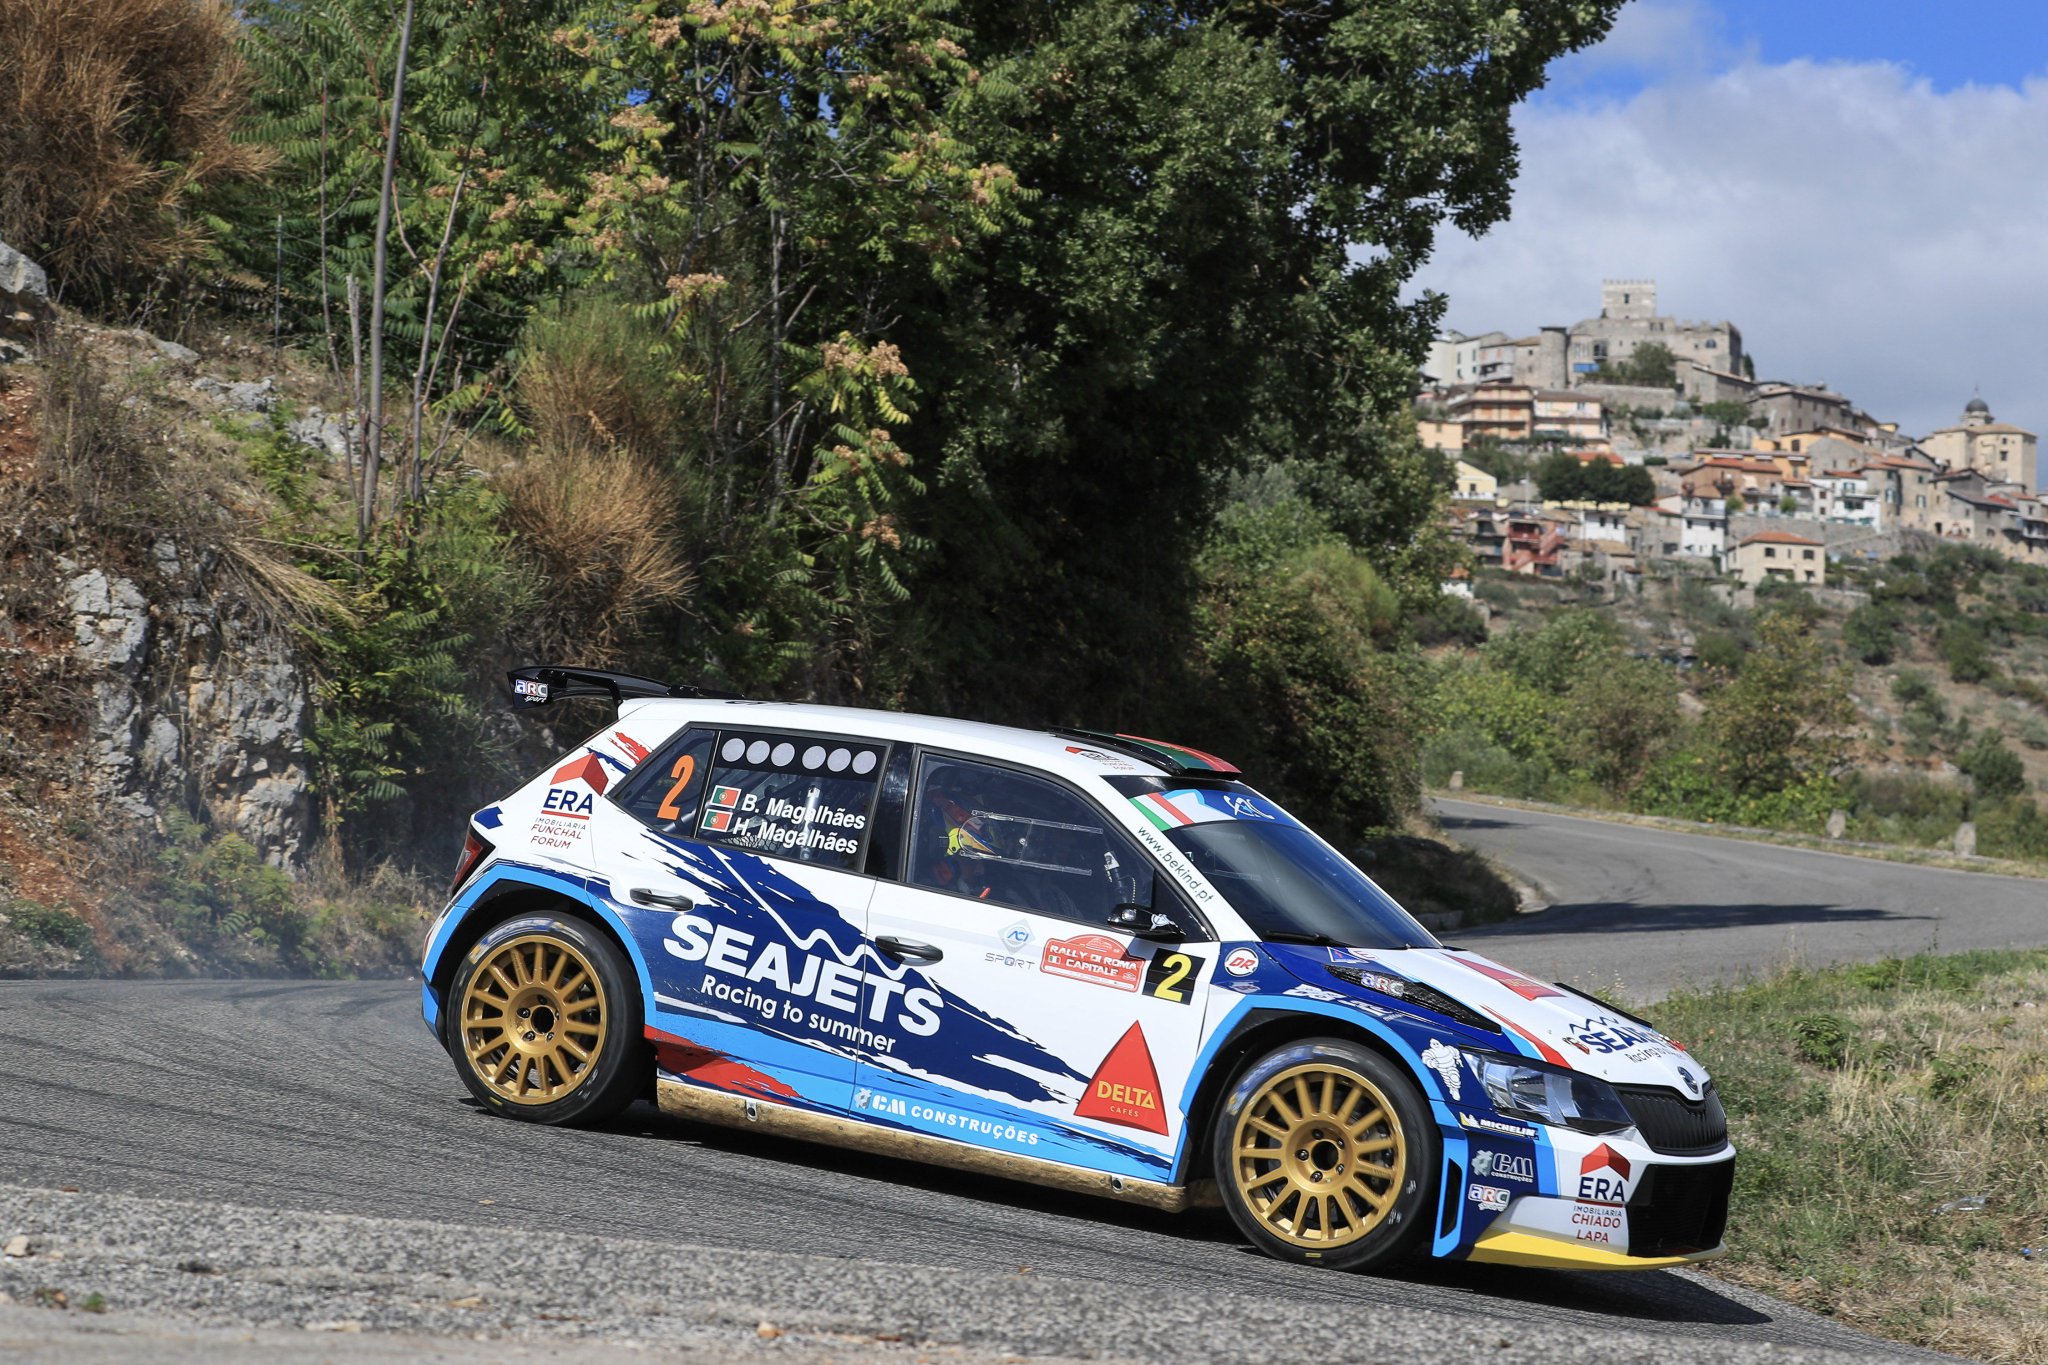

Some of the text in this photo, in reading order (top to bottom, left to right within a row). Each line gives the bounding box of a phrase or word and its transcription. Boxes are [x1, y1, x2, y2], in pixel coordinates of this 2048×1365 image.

[524, 695, 546, 703] sport
[656, 754, 695, 821] 2
[543, 788, 593, 814] ERA
[741, 794, 866, 829] B. Magalhães
[531, 824, 582, 840] FUNCHAL
[531, 836, 571, 849] FORUM
[733, 817, 858, 854] H. Magalhães
[1137, 826, 1214, 903] www.bekind.pt
[985, 952, 1035, 970] SPORT
[1050, 945, 1137, 971] RALLY DI ROMA
[1066, 959, 1119, 976] CAPITALE
[663, 914, 944, 1037] SEAJETS
[1153, 953, 1193, 1002] 2
[701, 974, 896, 1053] Racing to summer
[1097, 1080, 1156, 1110] DELTA
[872, 1094, 1039, 1145] CM CONSTRUÇÕES
[1480, 1119, 1535, 1137] MICHELIN
[1578, 1176, 1625, 1202] ERA
[1572, 1213, 1621, 1228] CHIADO
[1576, 1229, 1609, 1243] LAPA
